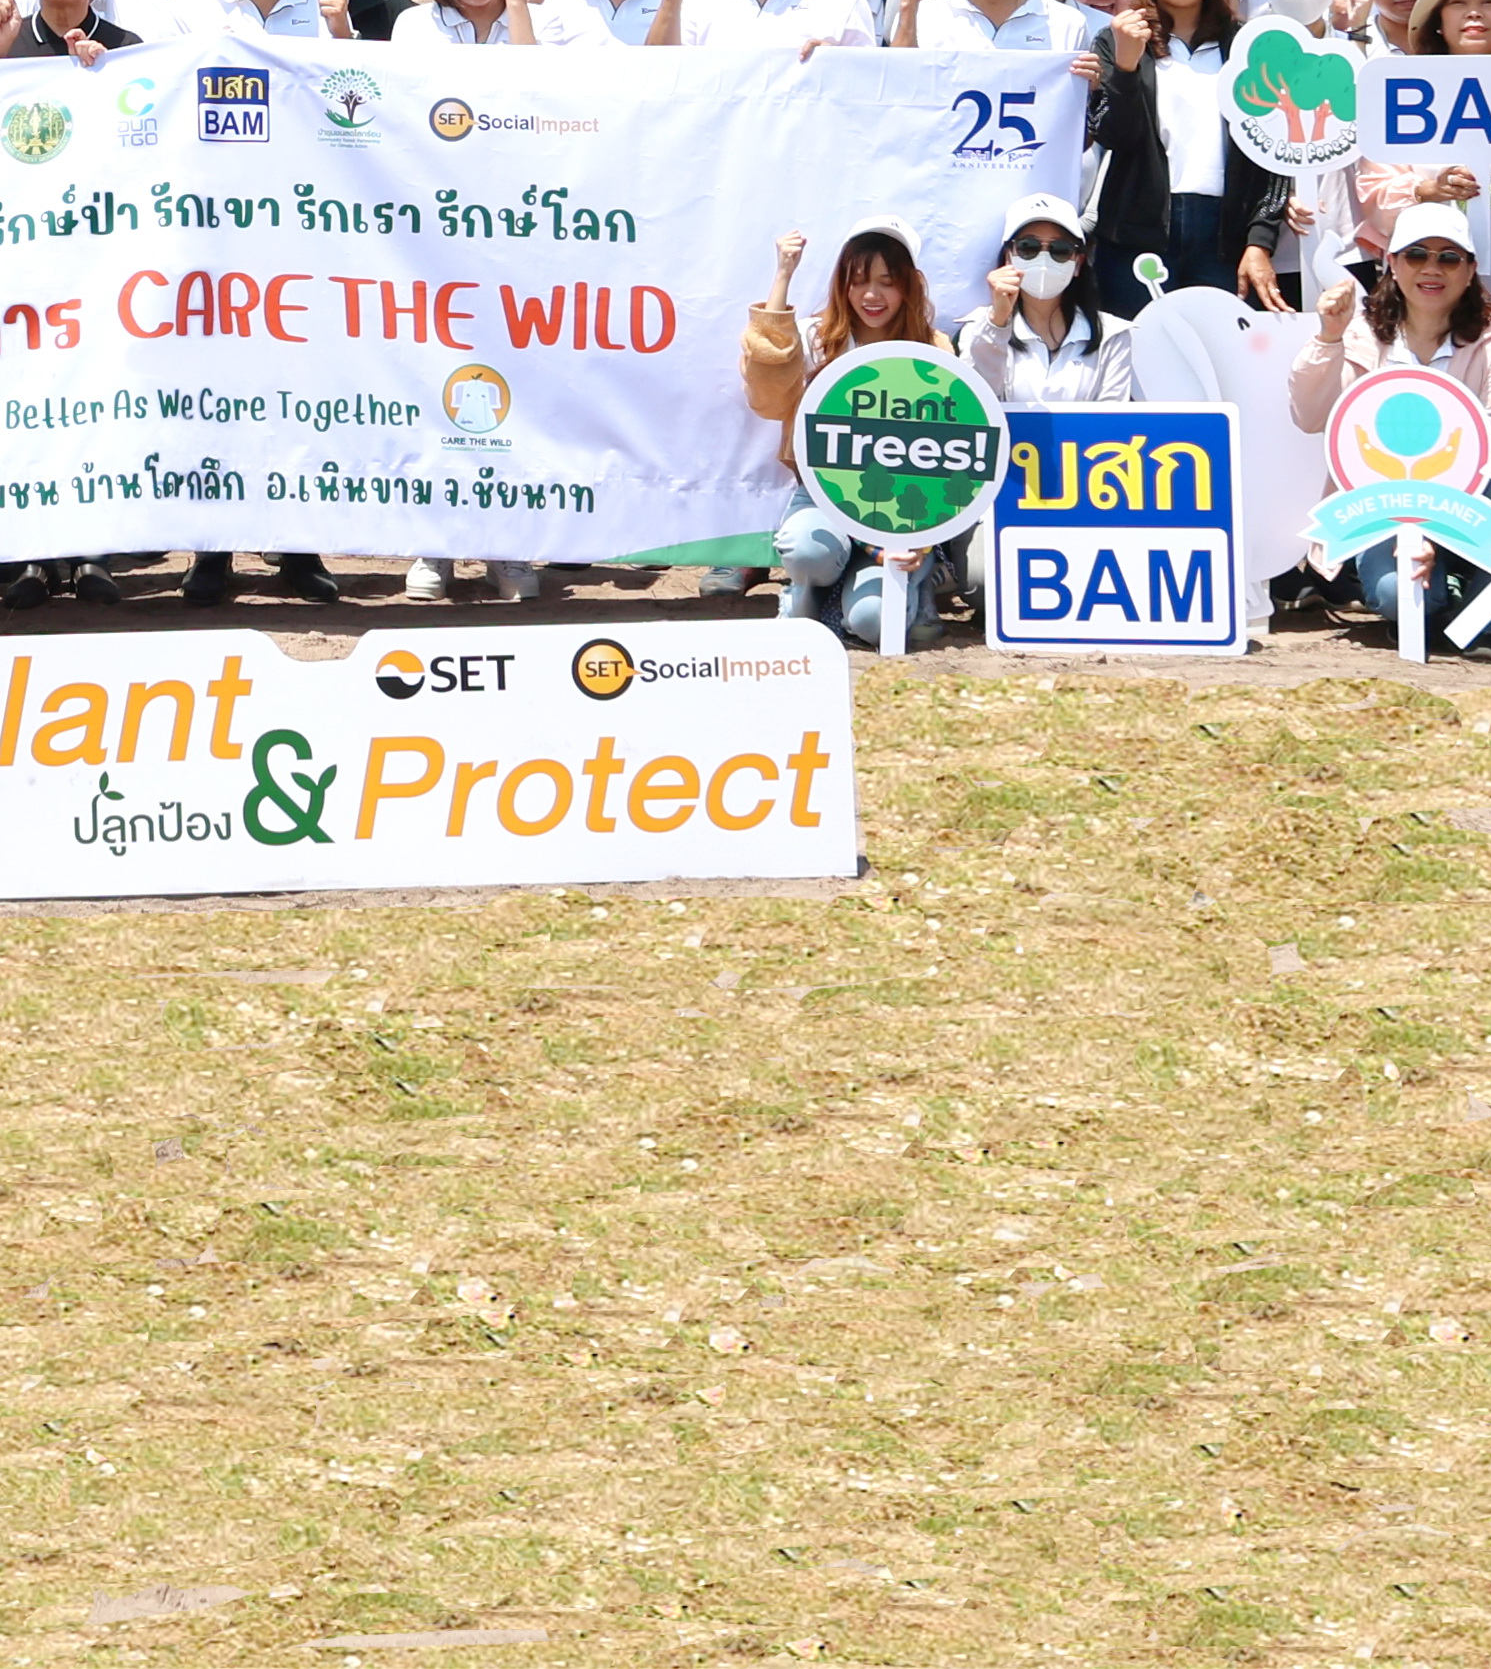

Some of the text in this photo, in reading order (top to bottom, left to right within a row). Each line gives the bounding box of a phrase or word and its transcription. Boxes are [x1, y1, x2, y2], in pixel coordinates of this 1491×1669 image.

[201, 74, 265, 100] บสก
[204, 110, 263, 135] BAM
[438, 112, 467, 126] SET
[951, 161, 1036, 171] ANNIVERSARY
[150, 180, 280, 229] รักเขา
[292, 182, 421, 235] รักเรา
[434, 183, 636, 244] รักษ์โลก
[116, 268, 315, 343] CARE
[327, 274, 482, 351] THE
[498, 280, 677, 354] WILD
[5, 396, 105, 430] Better
[114, 389, 149, 420] As
[276, 389, 421, 432] Together
[850, 388, 958, 423] Plant
[440, 436, 512, 447] CARE THE WILD
[815, 422, 989, 474] Trees!
[267, 460, 433, 505] อ.เนินขาม
[444, 466, 595, 514] จ.ชัยนาท
[1010, 434, 1214, 513] บสก
[1334, 493, 1488, 529] SAVE THE PLANET
[1017, 547, 1215, 624] BAM
[429, 654, 516, 694] SET
[584, 660, 623, 679] SET
[242, 727, 833, 847] & Protect
